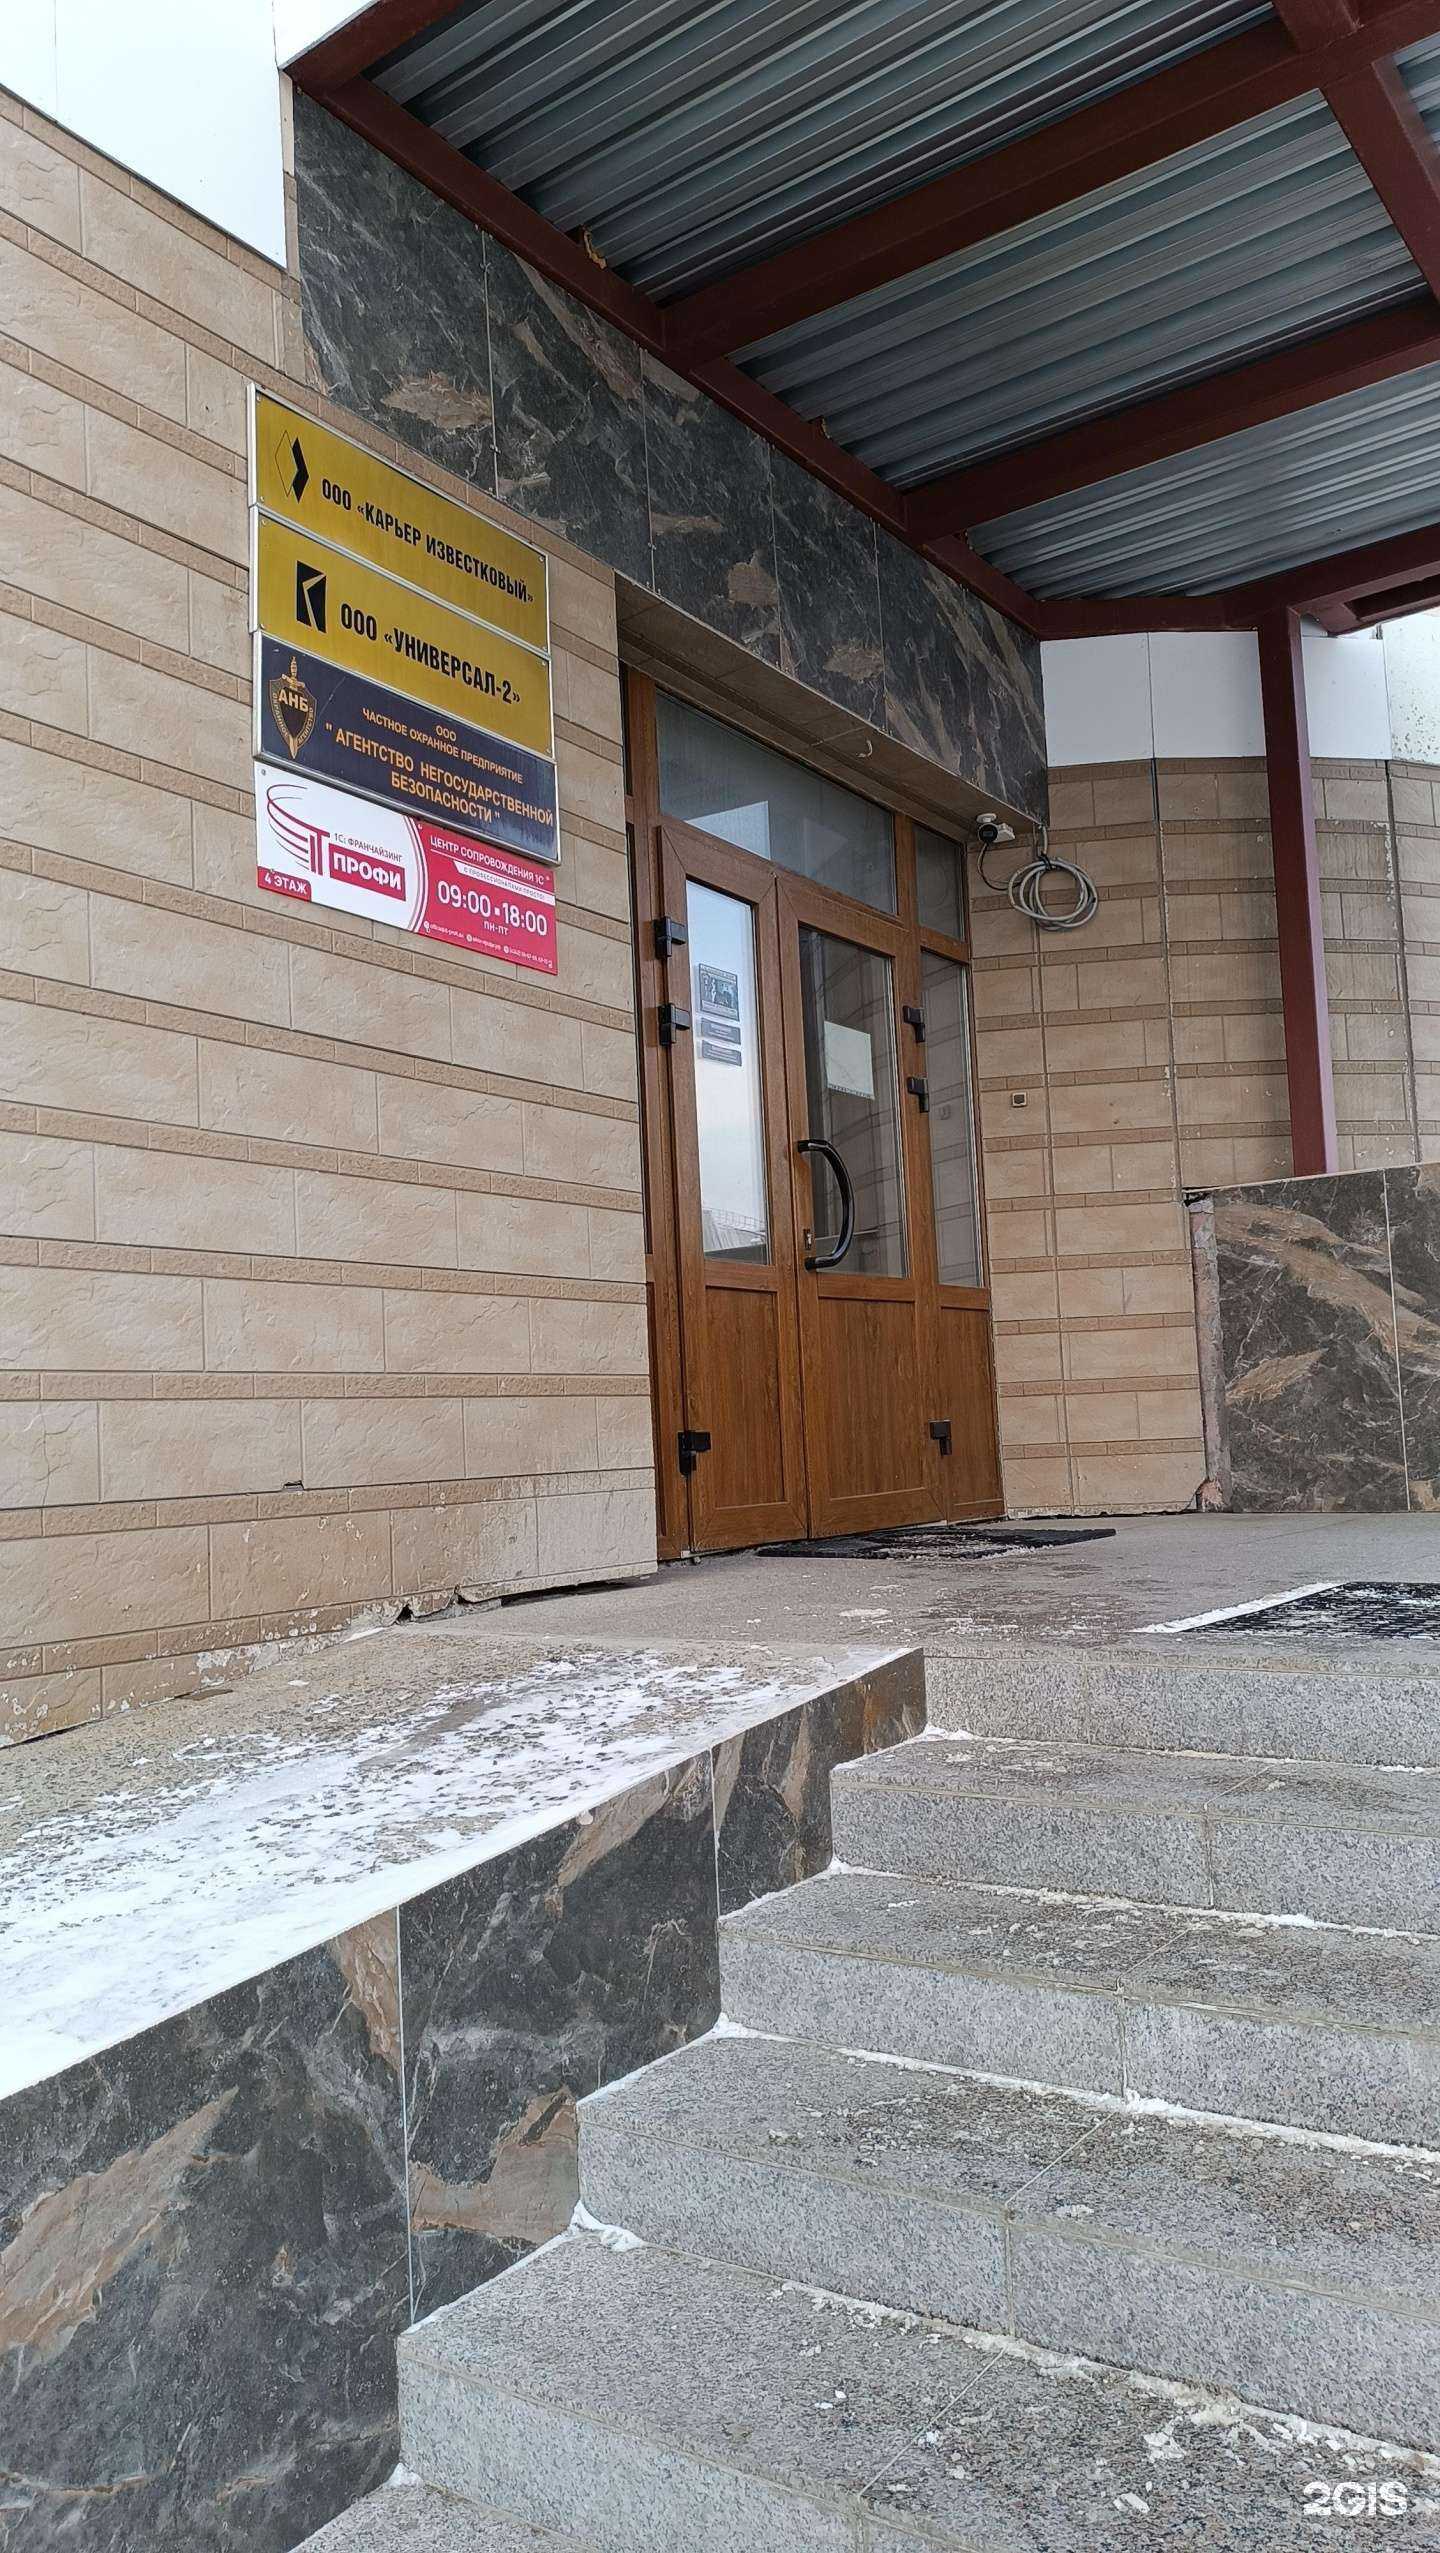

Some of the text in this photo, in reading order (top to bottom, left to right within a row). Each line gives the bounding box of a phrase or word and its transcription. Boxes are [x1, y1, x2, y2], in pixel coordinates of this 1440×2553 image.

[322, 478, 534, 603] ООО «КАРЬЕР ИЗВЕСТКОВЫЙ»
[340, 603, 521, 705] ООО «УНИВЕРСАЛ-2»
[278, 688, 309, 713] АНБ
[362, 707, 524, 785] ЧАСТНОЕ ОХРАННОЕ ПРЕДПРИЯТИЕ
[435, 724, 457, 743] ООО
[420, 760, 554, 827] НЕГОСУДАРСТВЕННОЙ
[333, 851, 402, 890] ПРОФИ
[430, 835, 460, 854] ЦЕНТР
[460, 845, 535, 882] СОПРОВОЖДЕНИЯ
[264, 874, 308, 896] 4 ЭТАЖ
[437, 880, 491, 918] 09:00
[502, 902, 548, 936] 18:00
[483, 920, 509, 936] ПН-ПТ
